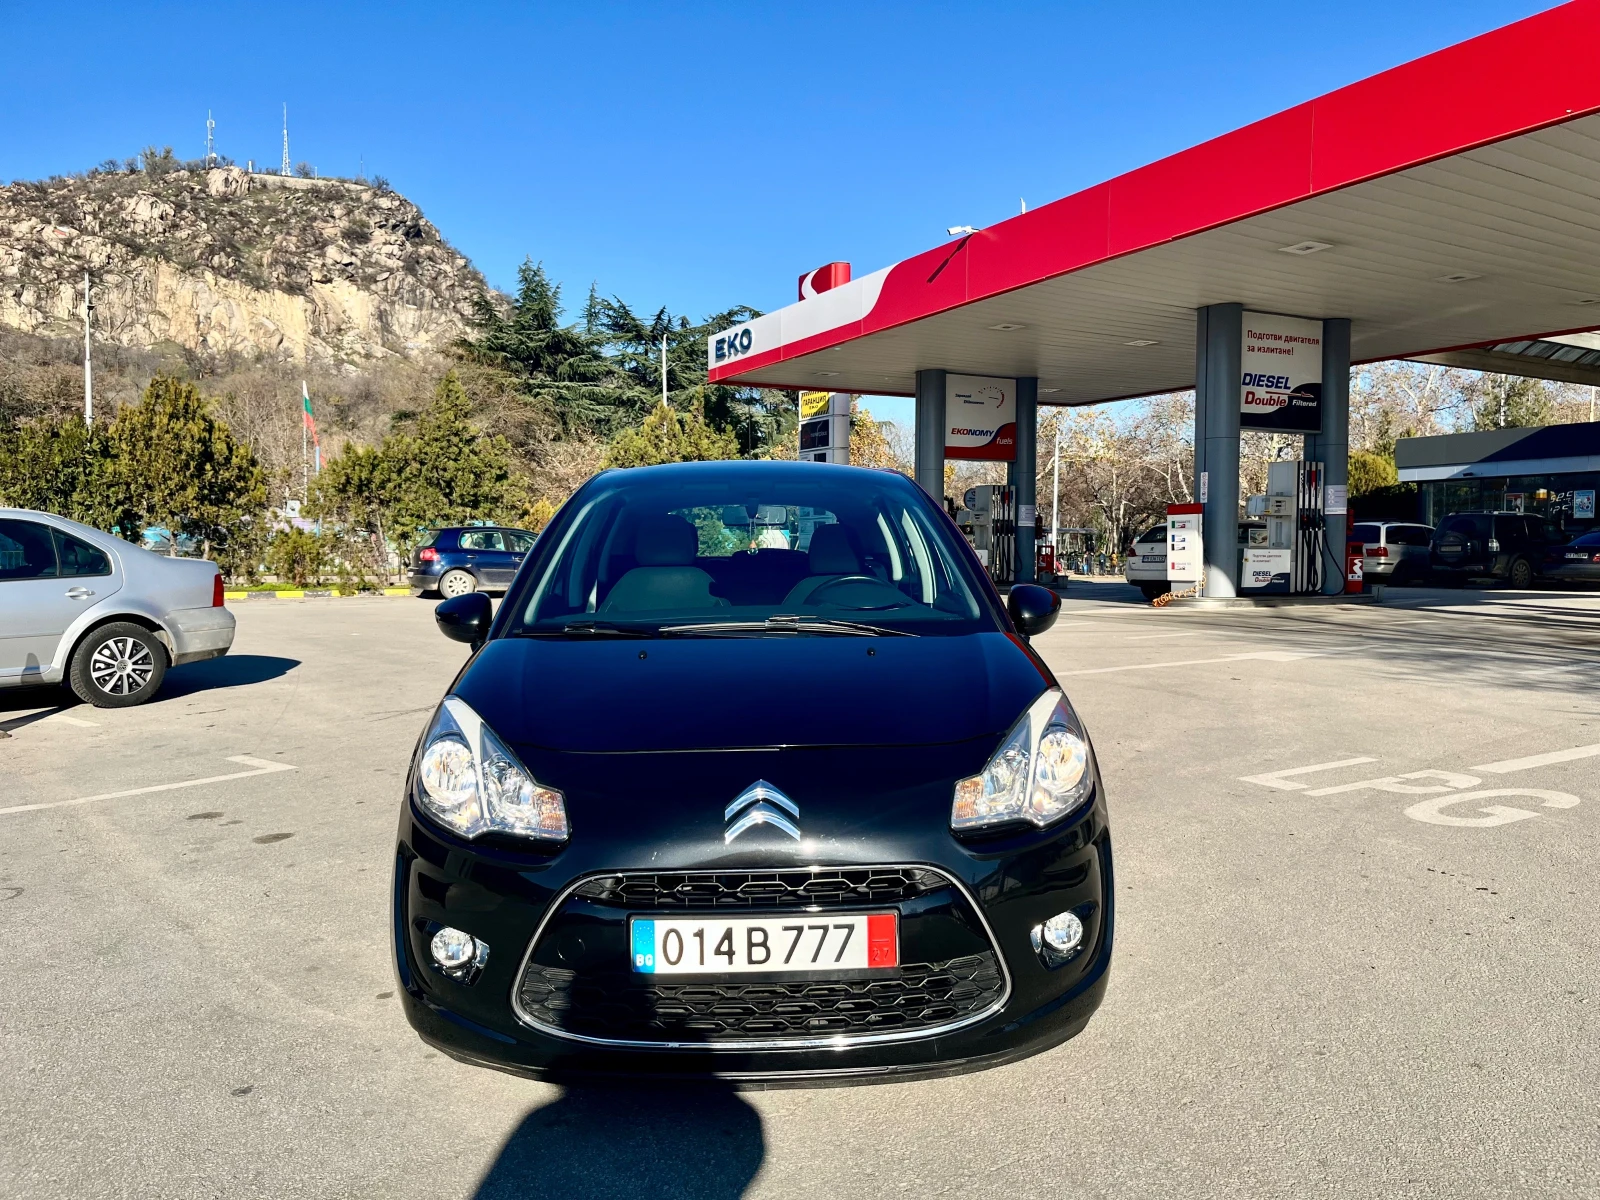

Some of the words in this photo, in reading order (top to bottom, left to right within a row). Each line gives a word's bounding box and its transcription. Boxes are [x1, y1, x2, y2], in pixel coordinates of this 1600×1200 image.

[715, 328, 753, 360] EKO
[1247, 330, 1282, 341] Подготви
[1284, 335, 1320, 345] двигателя
[1257, 346, 1294, 355] излитане!
[1242, 373, 1291, 390] DIESEL
[802, 395, 826, 406] ГАРАНЦИЯ
[1244, 391, 1287, 407] Double
[1292, 399, 1317, 407] Filtered
[951, 428, 994, 437] EKONOMY
[996, 437, 1013, 445] fuels
[1236, 757, 1581, 827] LPG
[636, 954, 653, 967] BG
